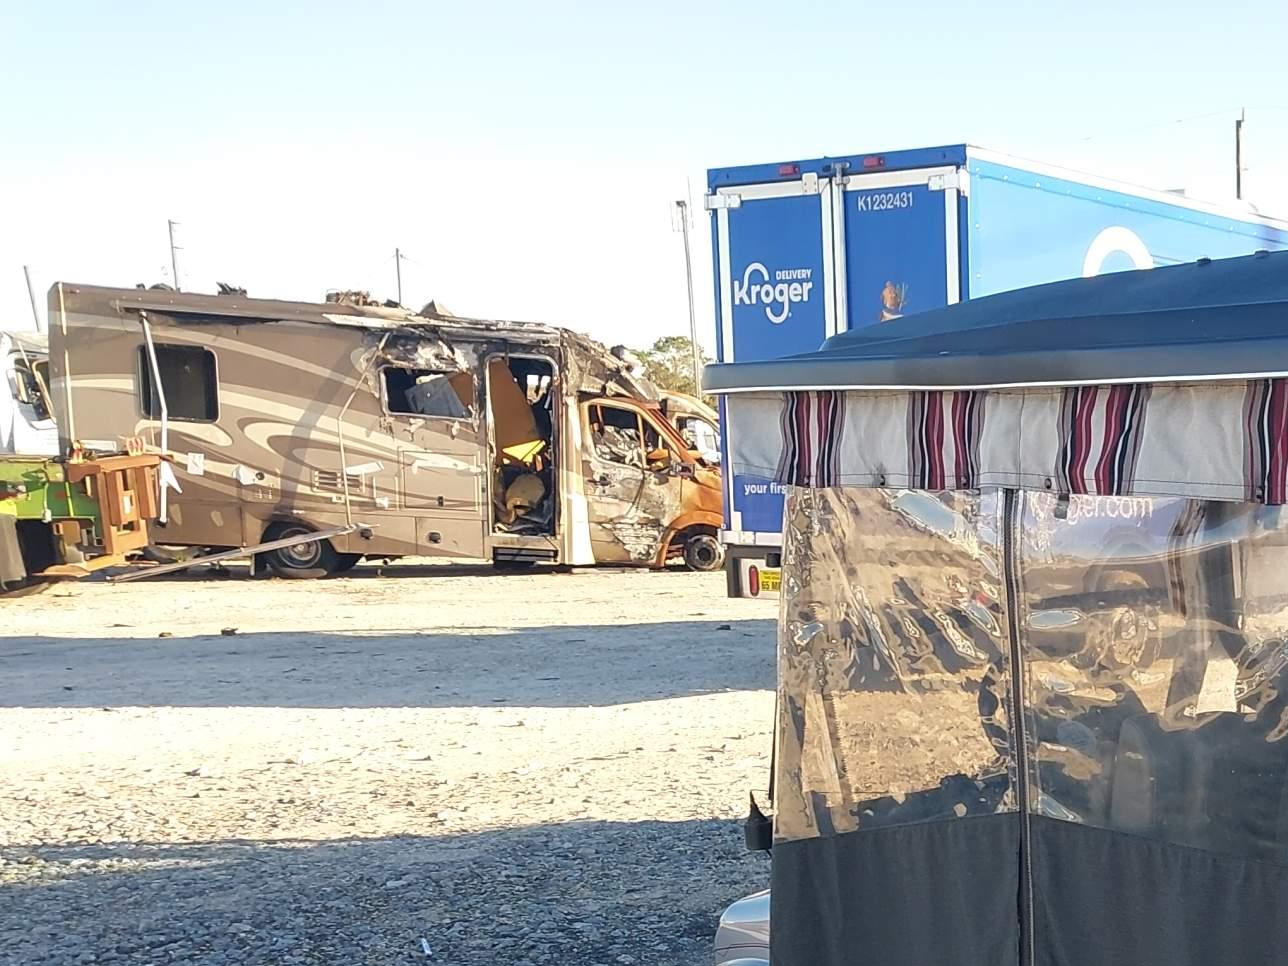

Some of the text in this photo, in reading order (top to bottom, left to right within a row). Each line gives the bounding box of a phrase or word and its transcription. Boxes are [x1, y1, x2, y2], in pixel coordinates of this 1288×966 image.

[857, 191, 913, 212] K1232431
[775, 269, 812, 280] DELIVERY
[734, 262, 813, 324] Kroger
[743, 482, 788, 496] your firs
